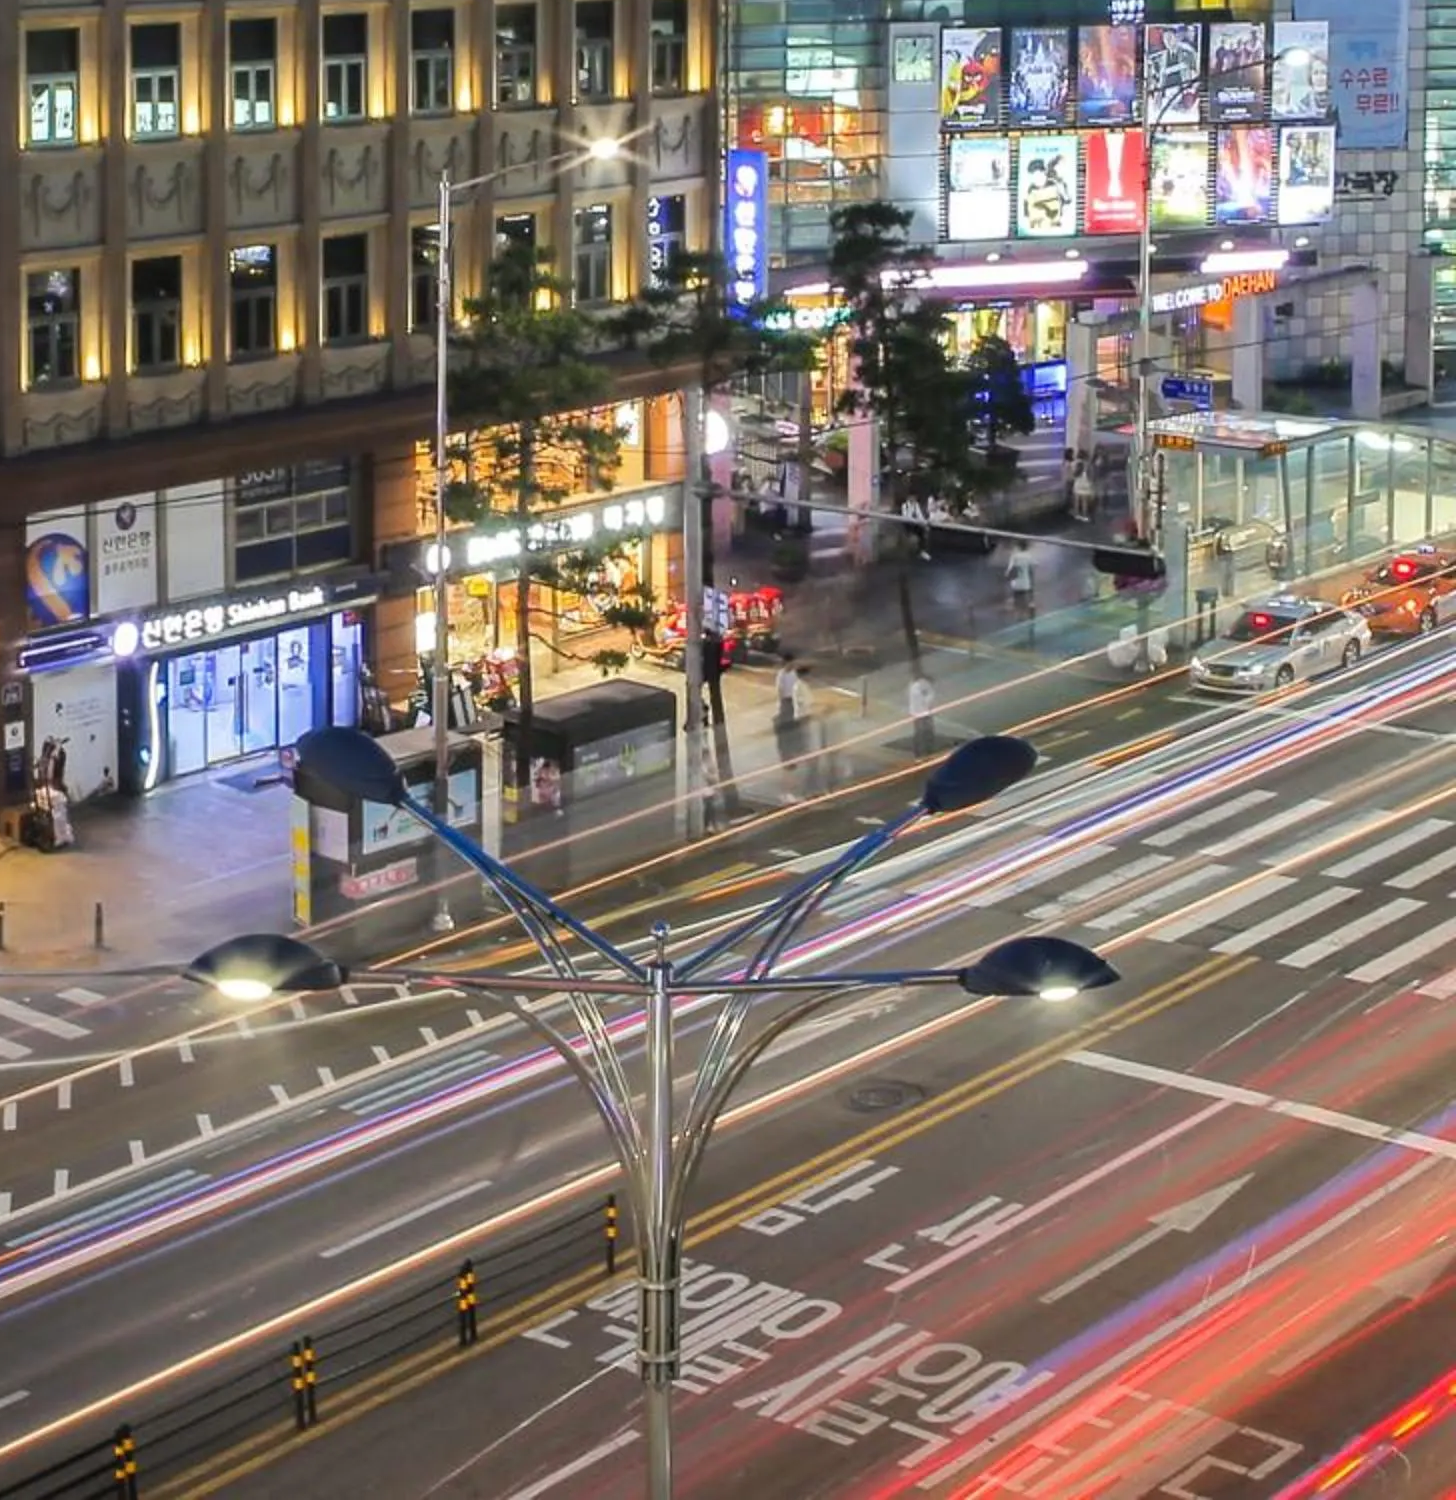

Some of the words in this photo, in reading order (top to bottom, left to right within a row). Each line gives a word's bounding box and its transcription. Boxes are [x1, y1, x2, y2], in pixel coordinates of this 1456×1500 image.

[1339, 66, 1390, 90] 수수료
[1151, 284, 1208, 313] WELCOME
[1223, 269, 1276, 300] DAEHAN
[142, 605, 226, 649] 신한은행
[227, 596, 287, 626] Shinhan
[288, 586, 325, 612] Bank
[733, 1322, 1055, 1469] 서울역
